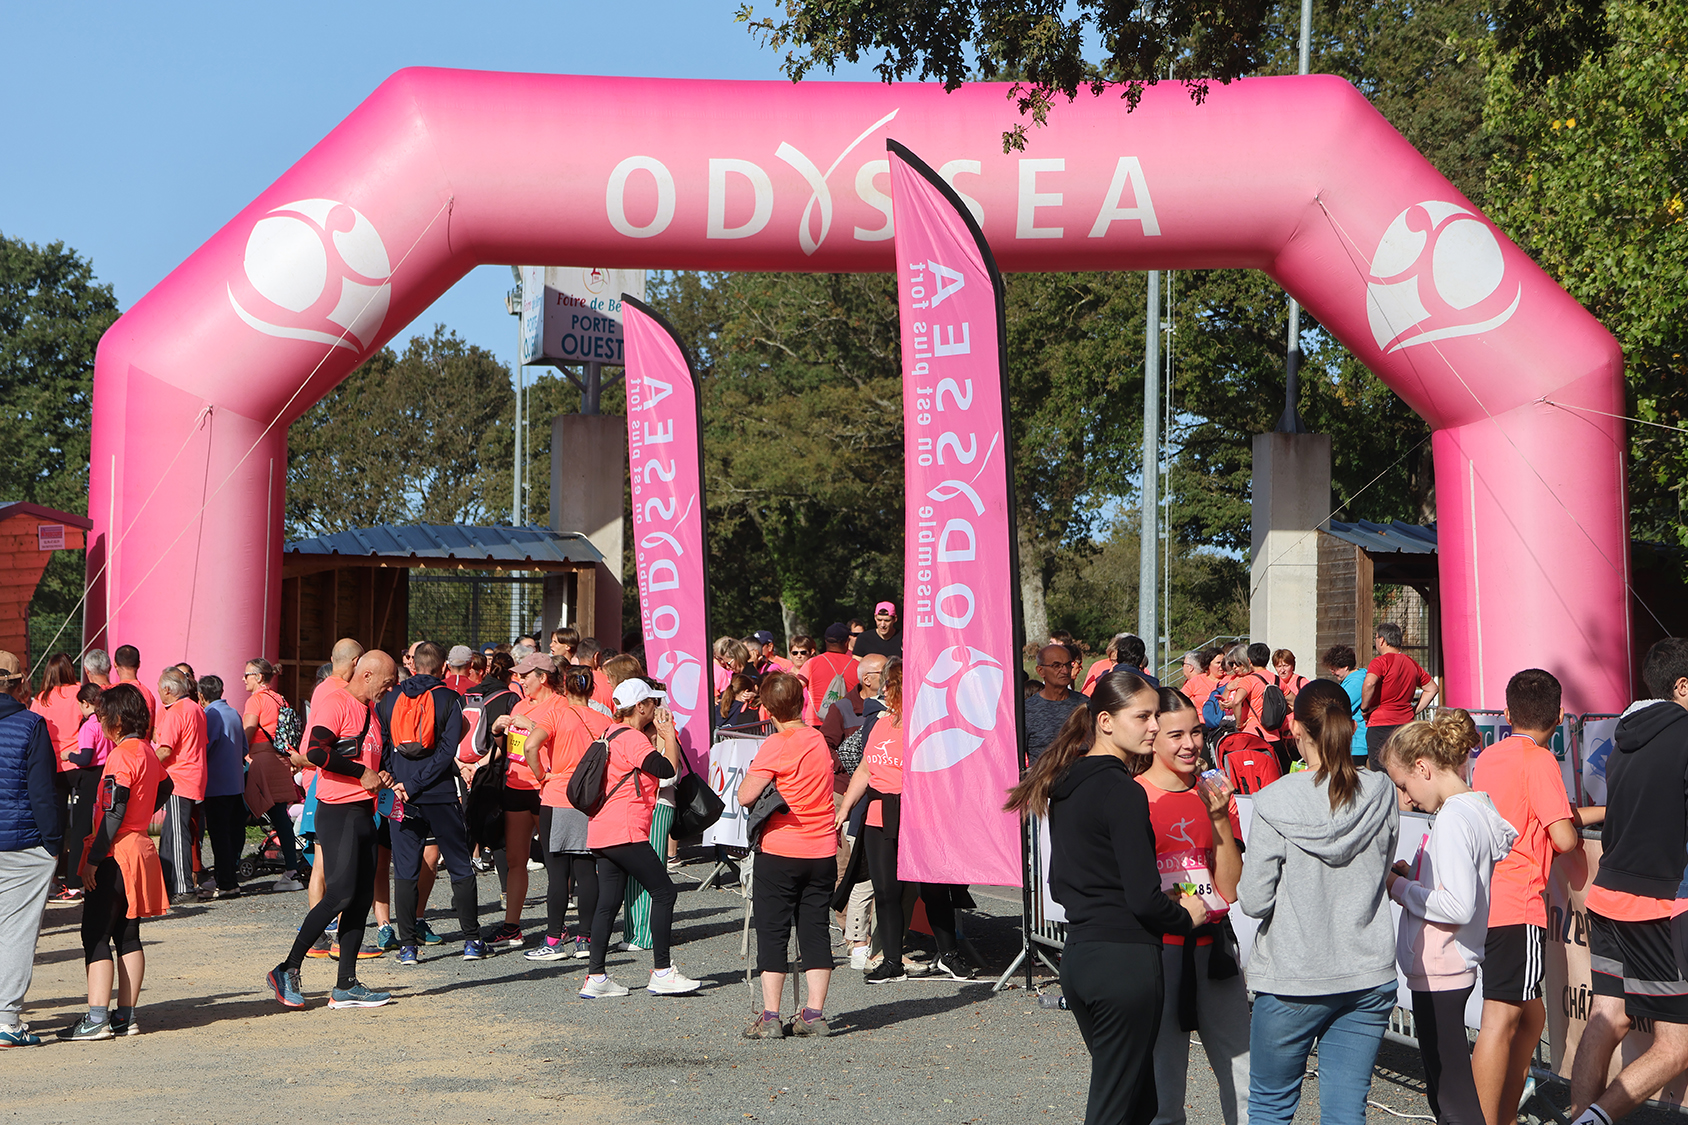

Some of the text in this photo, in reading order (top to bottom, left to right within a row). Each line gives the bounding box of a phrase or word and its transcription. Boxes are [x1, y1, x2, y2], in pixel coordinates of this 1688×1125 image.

[557, 292, 587, 308] Foire
[590, 297, 605, 311] de
[608, 298, 622, 312] Bé
[571, 314, 615, 334] PORTE
[561, 333, 624, 360] OUEST
[1195, 883, 1213, 895] 85
